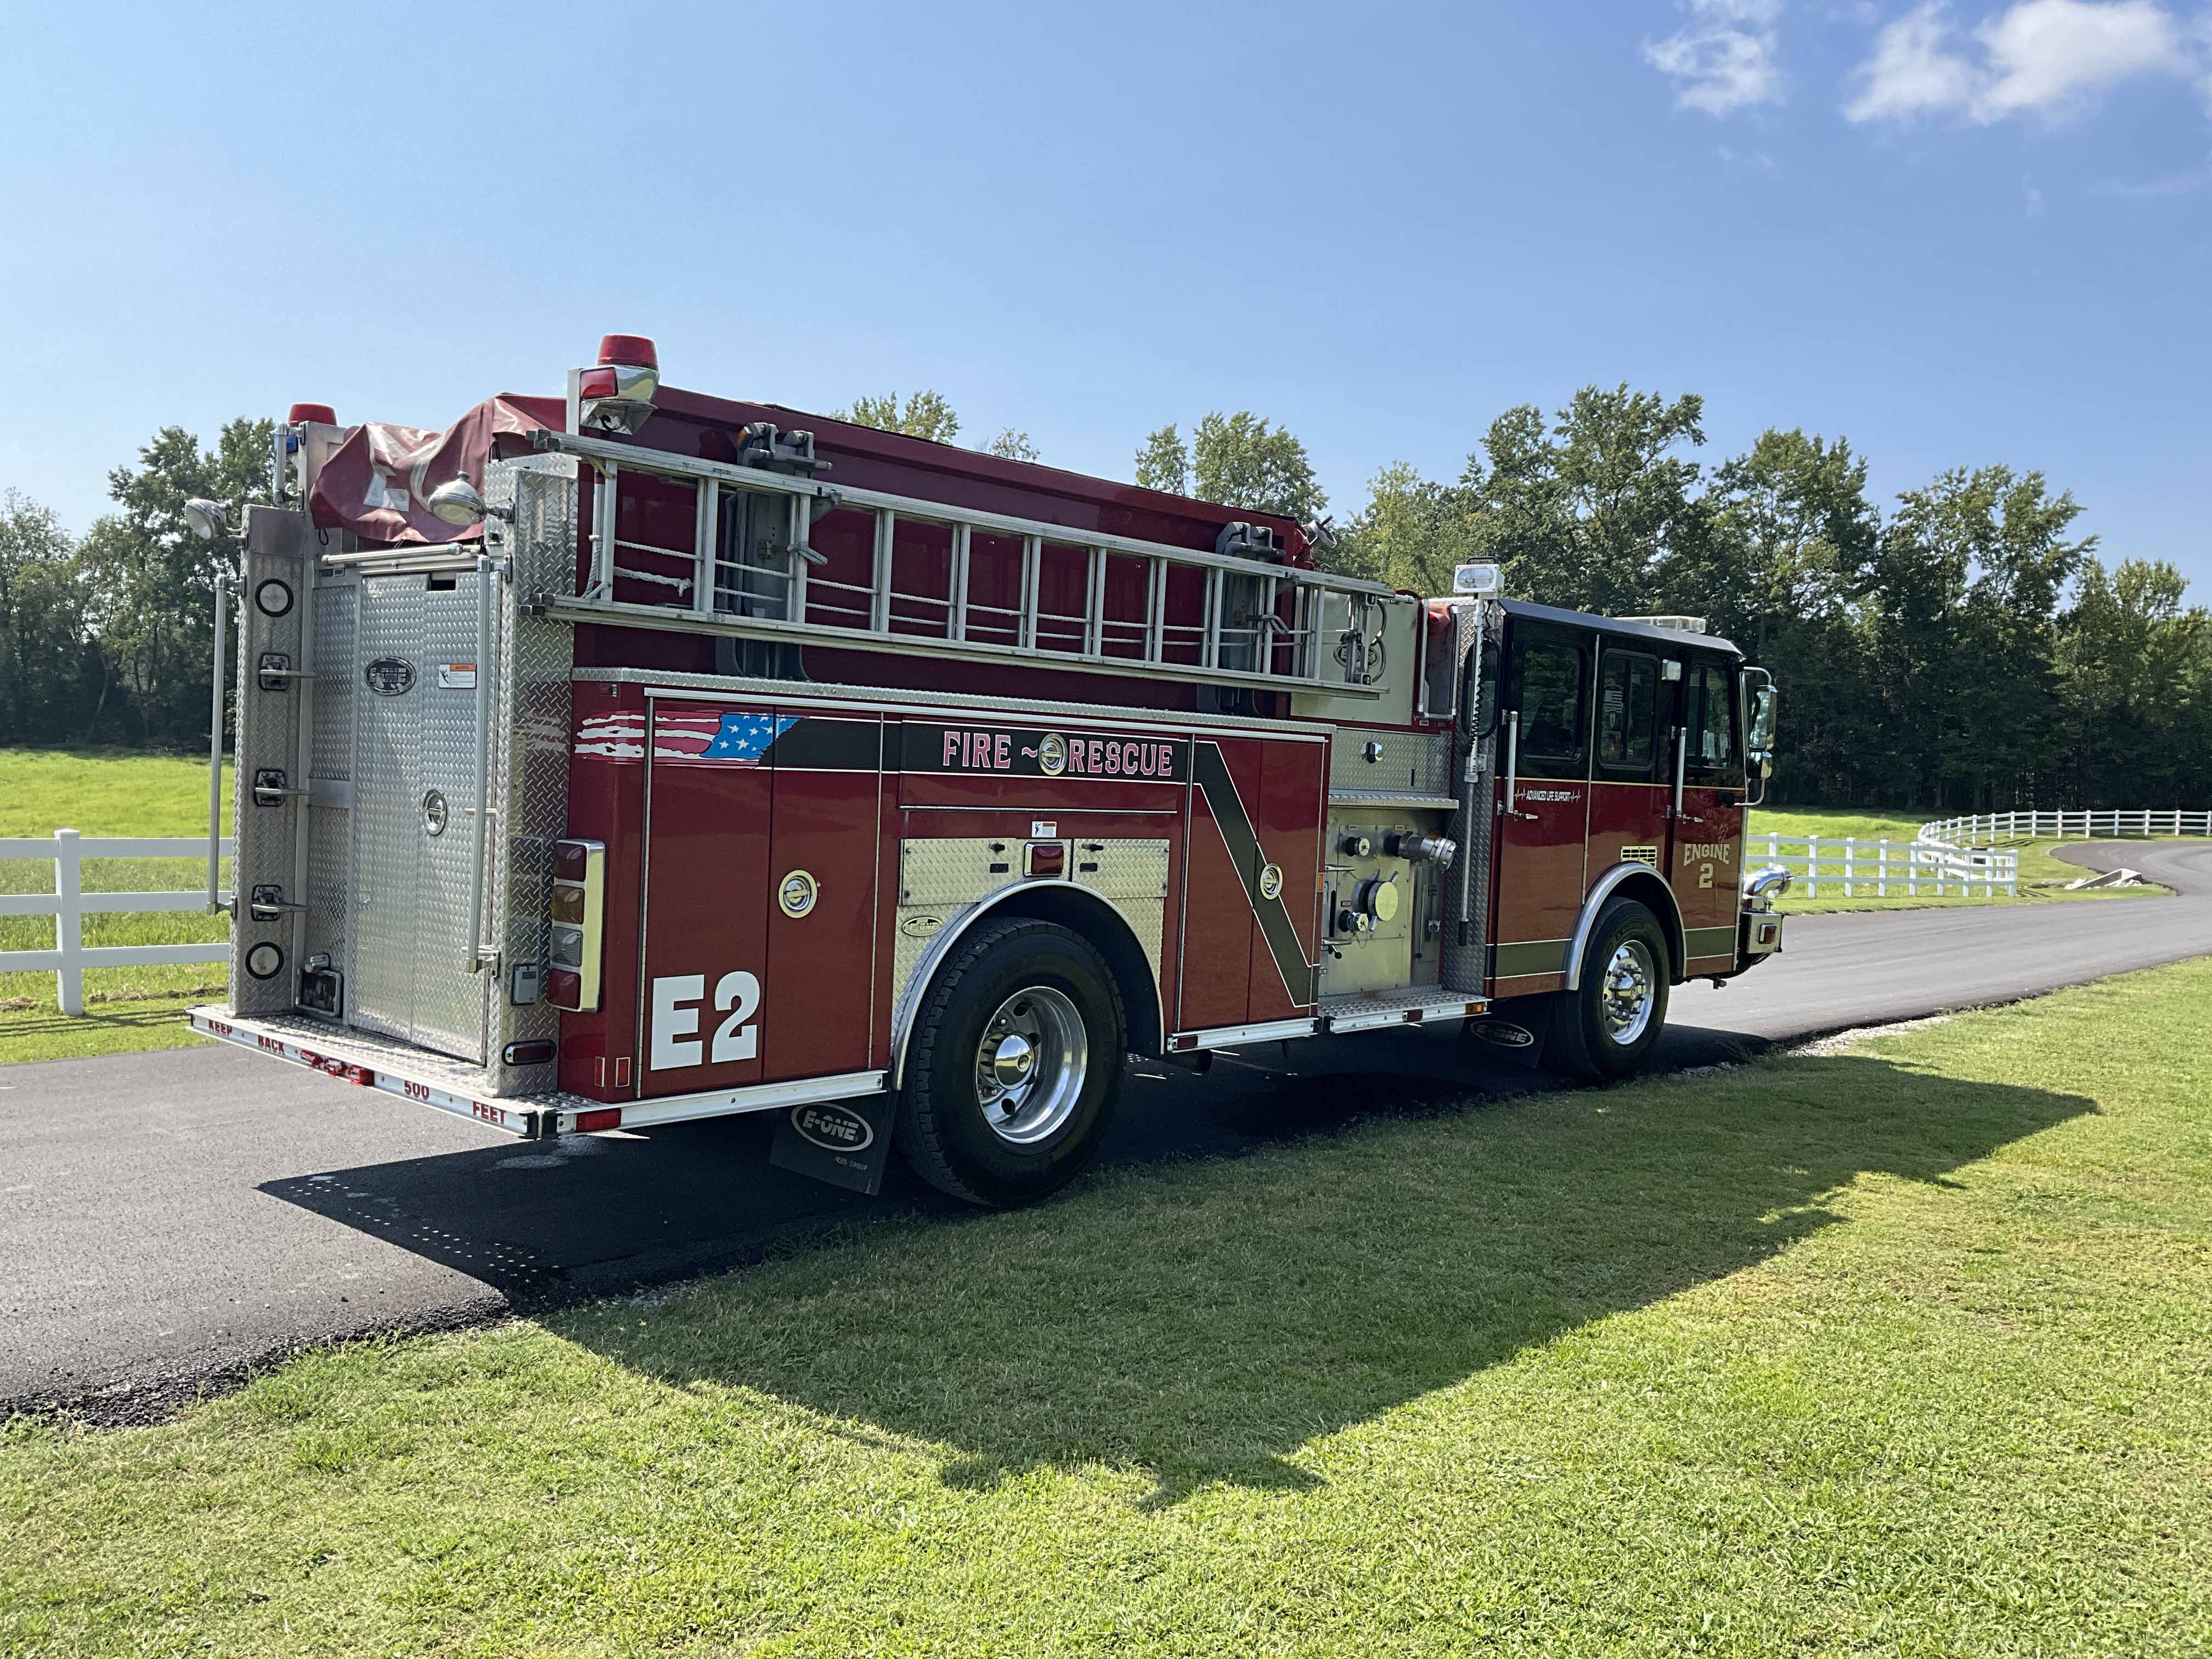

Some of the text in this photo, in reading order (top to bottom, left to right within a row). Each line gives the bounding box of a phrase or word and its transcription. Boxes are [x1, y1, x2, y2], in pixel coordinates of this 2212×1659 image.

[943, 731, 1172, 776] FIRE RESCUE
[1526, 790, 1547, 800] ADVANCED
[1554, 791, 1571, 802] SUPPORT
[1684, 843, 1730, 867] ENGINE
[1699, 863, 1713, 888] 2
[651, 970, 760, 1071] E2
[208, 1019, 506, 1124] KEEP BACK 500 FEET
[803, 1110, 859, 1141] E-ONE
